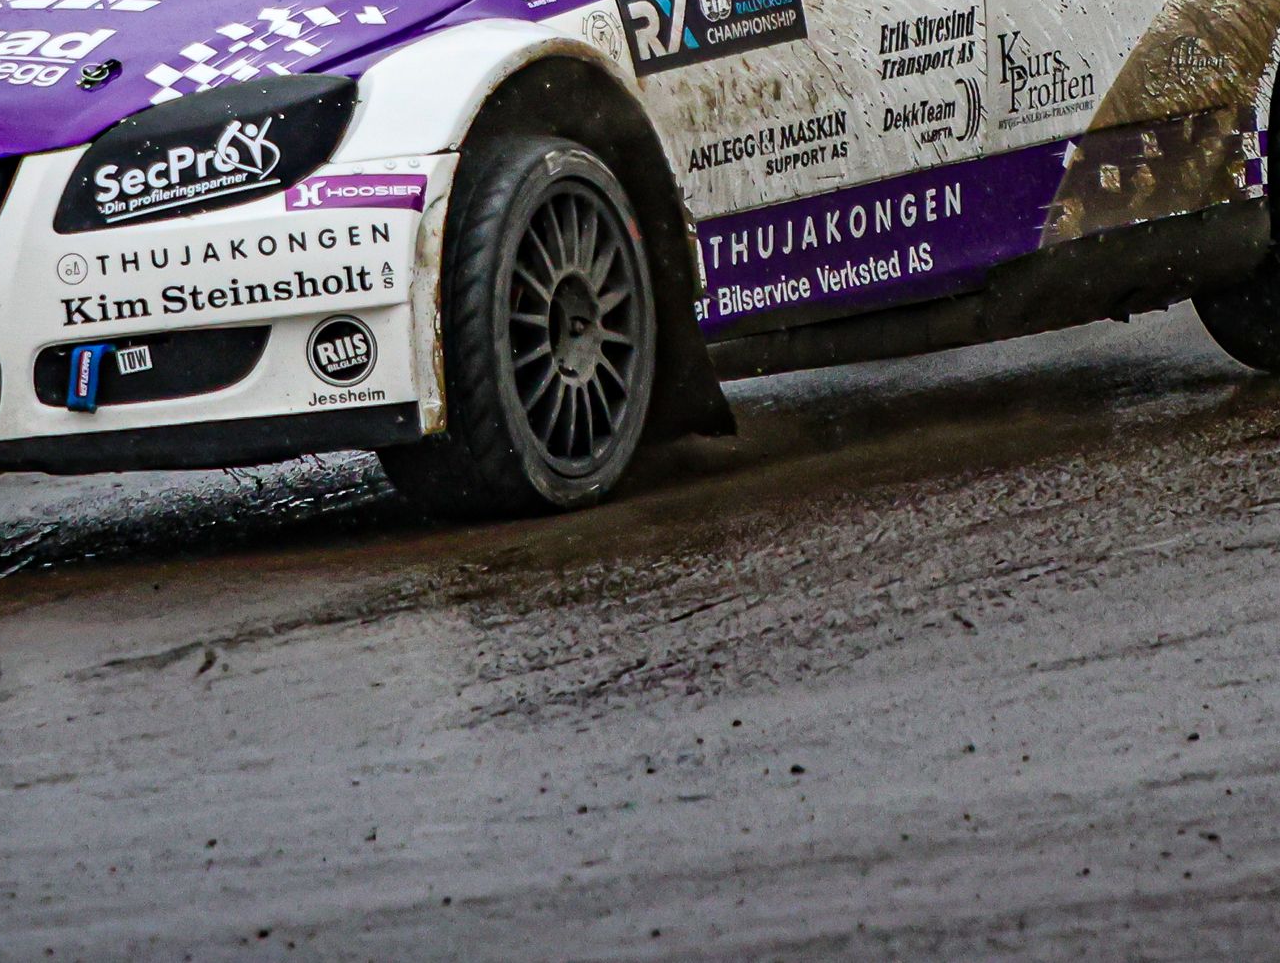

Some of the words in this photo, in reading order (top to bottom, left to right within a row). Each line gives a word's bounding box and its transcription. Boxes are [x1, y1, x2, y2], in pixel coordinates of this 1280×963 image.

[706, 10, 797, 45] CHAMPIONSHIP
[879, 19, 910, 54] Erik
[914, 5, 975, 47] Sivesind
[881, 45, 954, 80] Transport
[956, 41, 976, 64] AS
[997, 31, 1064, 84] Kurs
[883, 99, 956, 132] DekkTeam
[688, 133, 755, 174] ANLEGG
[779, 111, 847, 150] MASKIN
[766, 146, 826, 175] SUPPORT
[831, 141, 848, 159] AS
[94, 145, 241, 203] SecPro
[129, 172, 249, 212] profileringspartner
[326, 185, 422, 198] HOOSIER
[709, 182, 962, 269] THUJAKONGEN
[96, 222, 390, 276] THUJAKONGEN
[60, 293, 152, 327] Kim
[161, 265, 373, 315] Steinsholt
[718, 274, 811, 316] Bilservice
[816, 249, 901, 294] Verksted
[908, 242, 934, 274] AS
[119, 349, 148, 371] TOW
[317, 332, 368, 366] RIIS
[326, 354, 369, 374] BILGLASS
[308, 387, 386, 407] Jessheim
